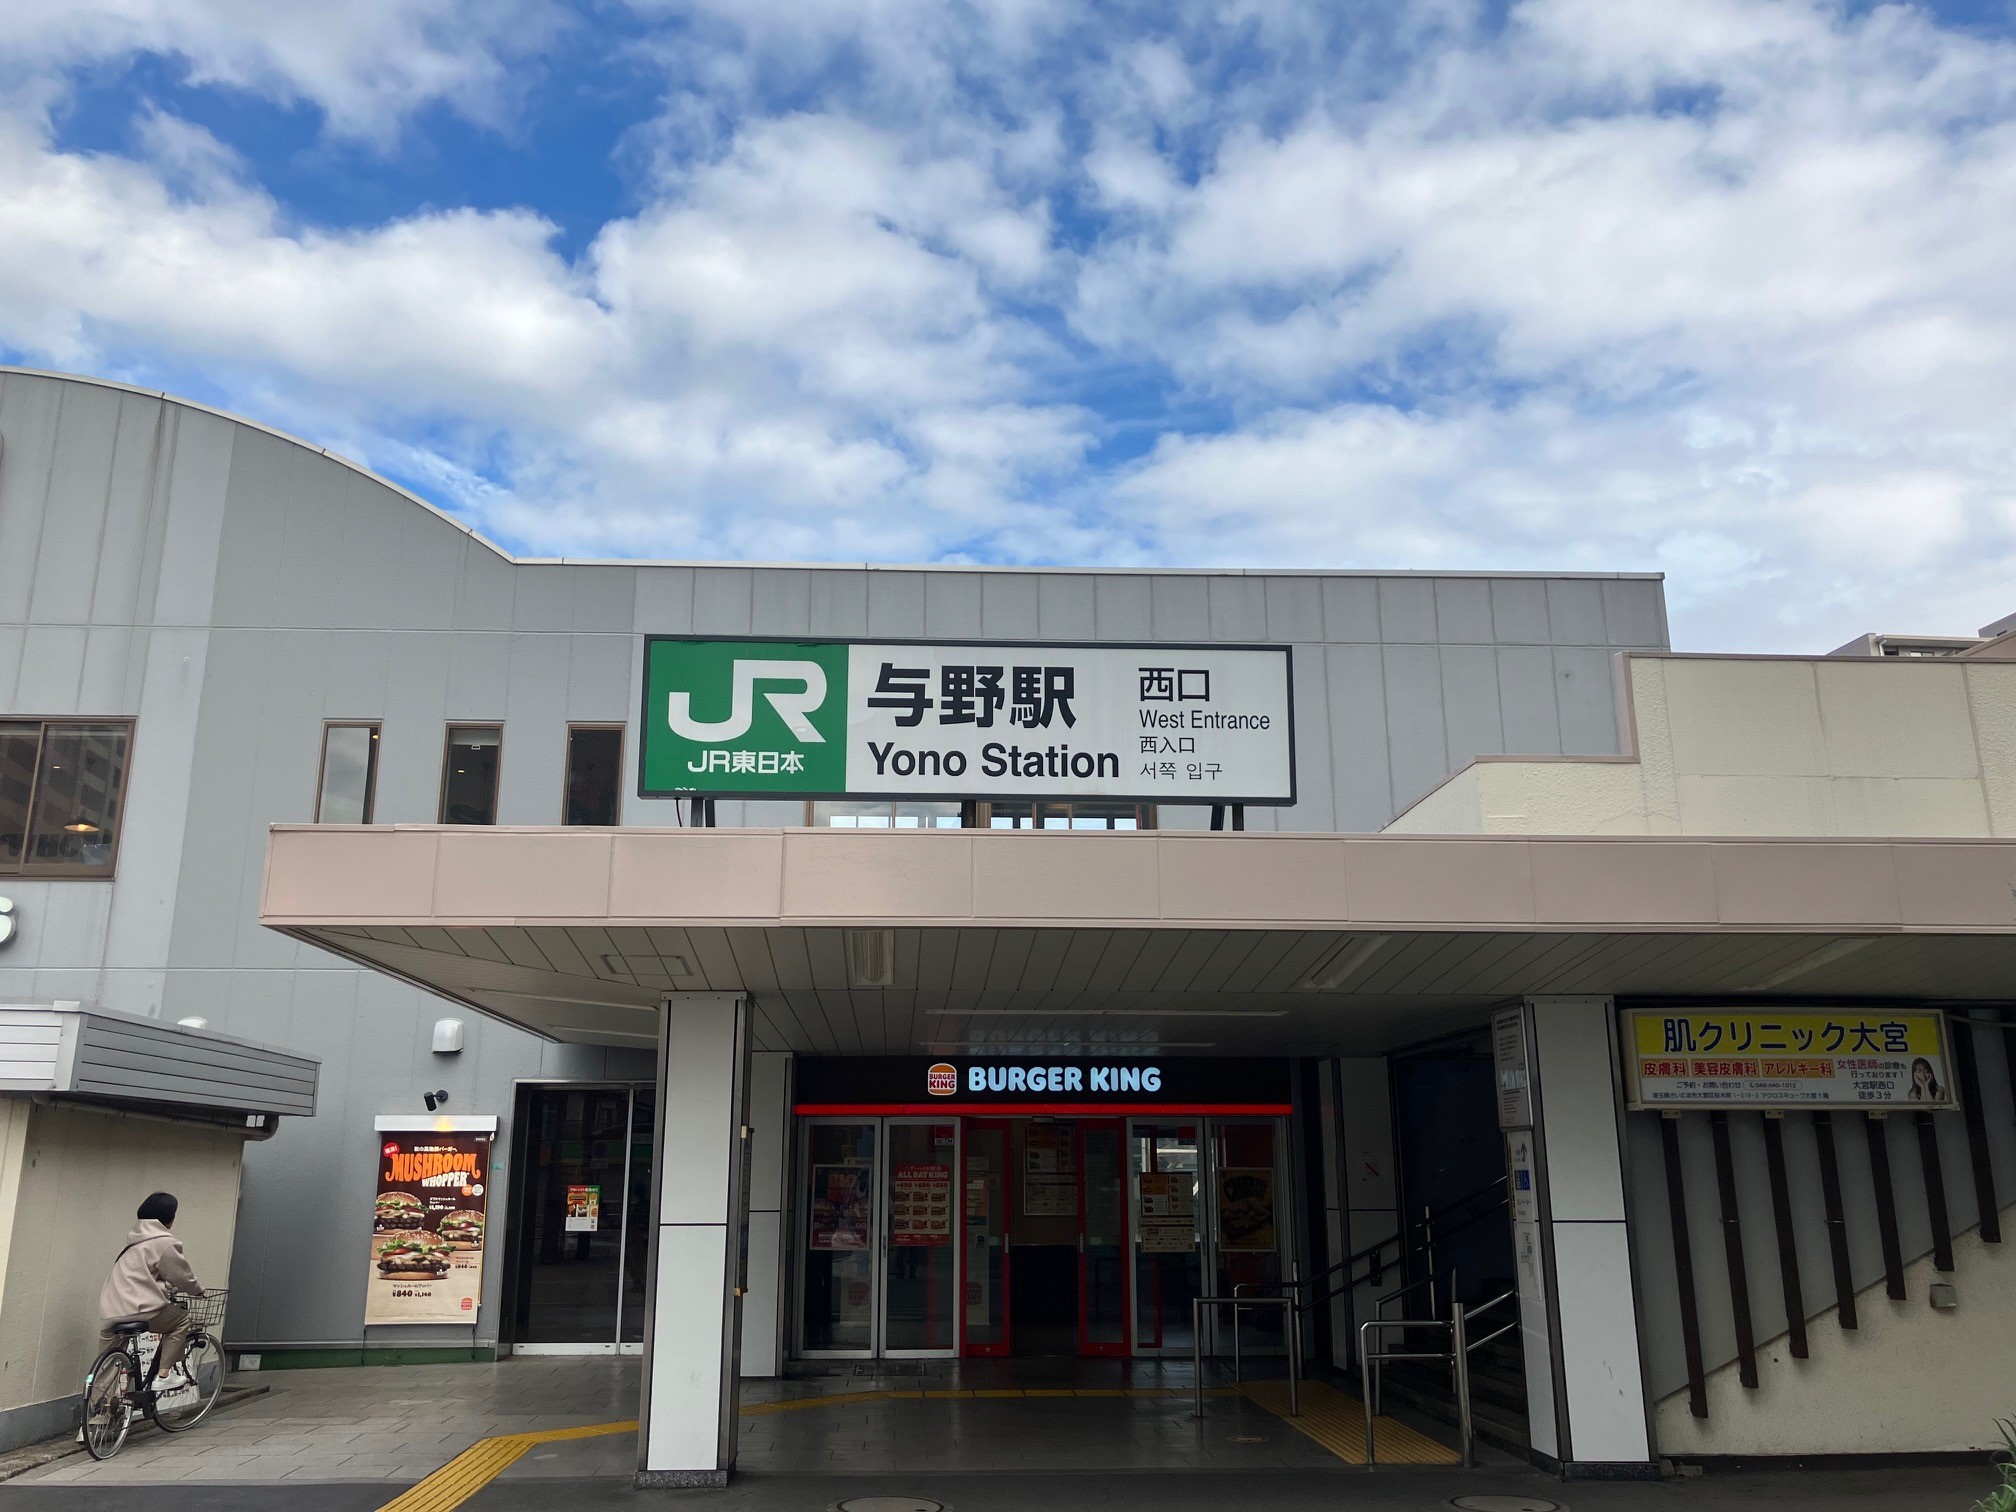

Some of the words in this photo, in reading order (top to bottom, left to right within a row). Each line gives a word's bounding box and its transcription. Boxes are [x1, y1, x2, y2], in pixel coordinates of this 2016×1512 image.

[1139, 668, 1210, 702] 西口
[668, 659, 827, 743] JR
[868, 662, 1077, 729] 与野駅
[1139, 709, 1185, 729] West
[1191, 710, 1271, 731] Entrance
[1139, 736, 1195, 754] 西入口
[687, 750, 804, 775] JR東日本
[868, 741, 967, 779] Yono
[981, 743, 1119, 778] Station
[1139, 761, 1177, 780] 서쪽
[1186, 763, 1222, 780] 입구
[1664, 1018, 1909, 1052] 肌クリニック大宮
[1644, 1062, 1687, 1076] 皮膚科
[1694, 1062, 1757, 1076] 美容皮膚科
[1836, 1059, 1907, 1070] 女性医師の診療も
[929, 1080, 956, 1089] KING
[969, 1066, 1083, 1091] BURGER
[1090, 1066, 1161, 1091] KING
[1676, 1081, 1741, 1089] ご予約・お問い合わせ
[1853, 1081, 1895, 1090] 大宮駅西口
[1858, 1091, 1892, 1100] 徒歩3分
[385, 1153, 481, 1181] MUSHROOM
[421, 1171, 468, 1187] WHOPPER
